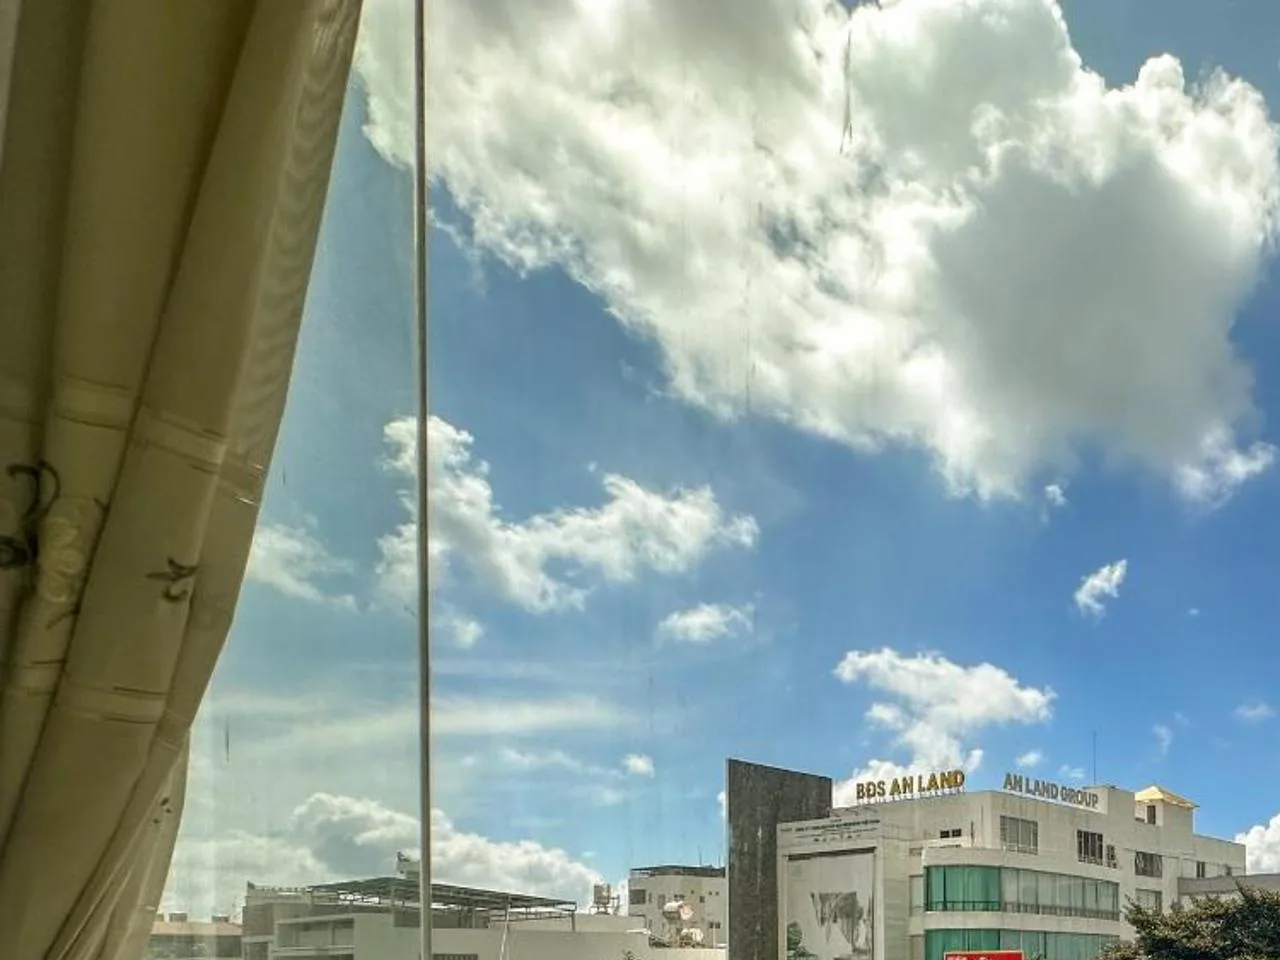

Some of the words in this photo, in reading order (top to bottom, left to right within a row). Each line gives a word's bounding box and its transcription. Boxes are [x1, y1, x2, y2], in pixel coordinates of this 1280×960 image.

[889, 777, 914, 796] AN
[917, 770, 965, 793] LAND
[1003, 772, 1023, 793] AN
[1025, 777, 1059, 800] LAND
[1061, 785, 1099, 808] GROUP
